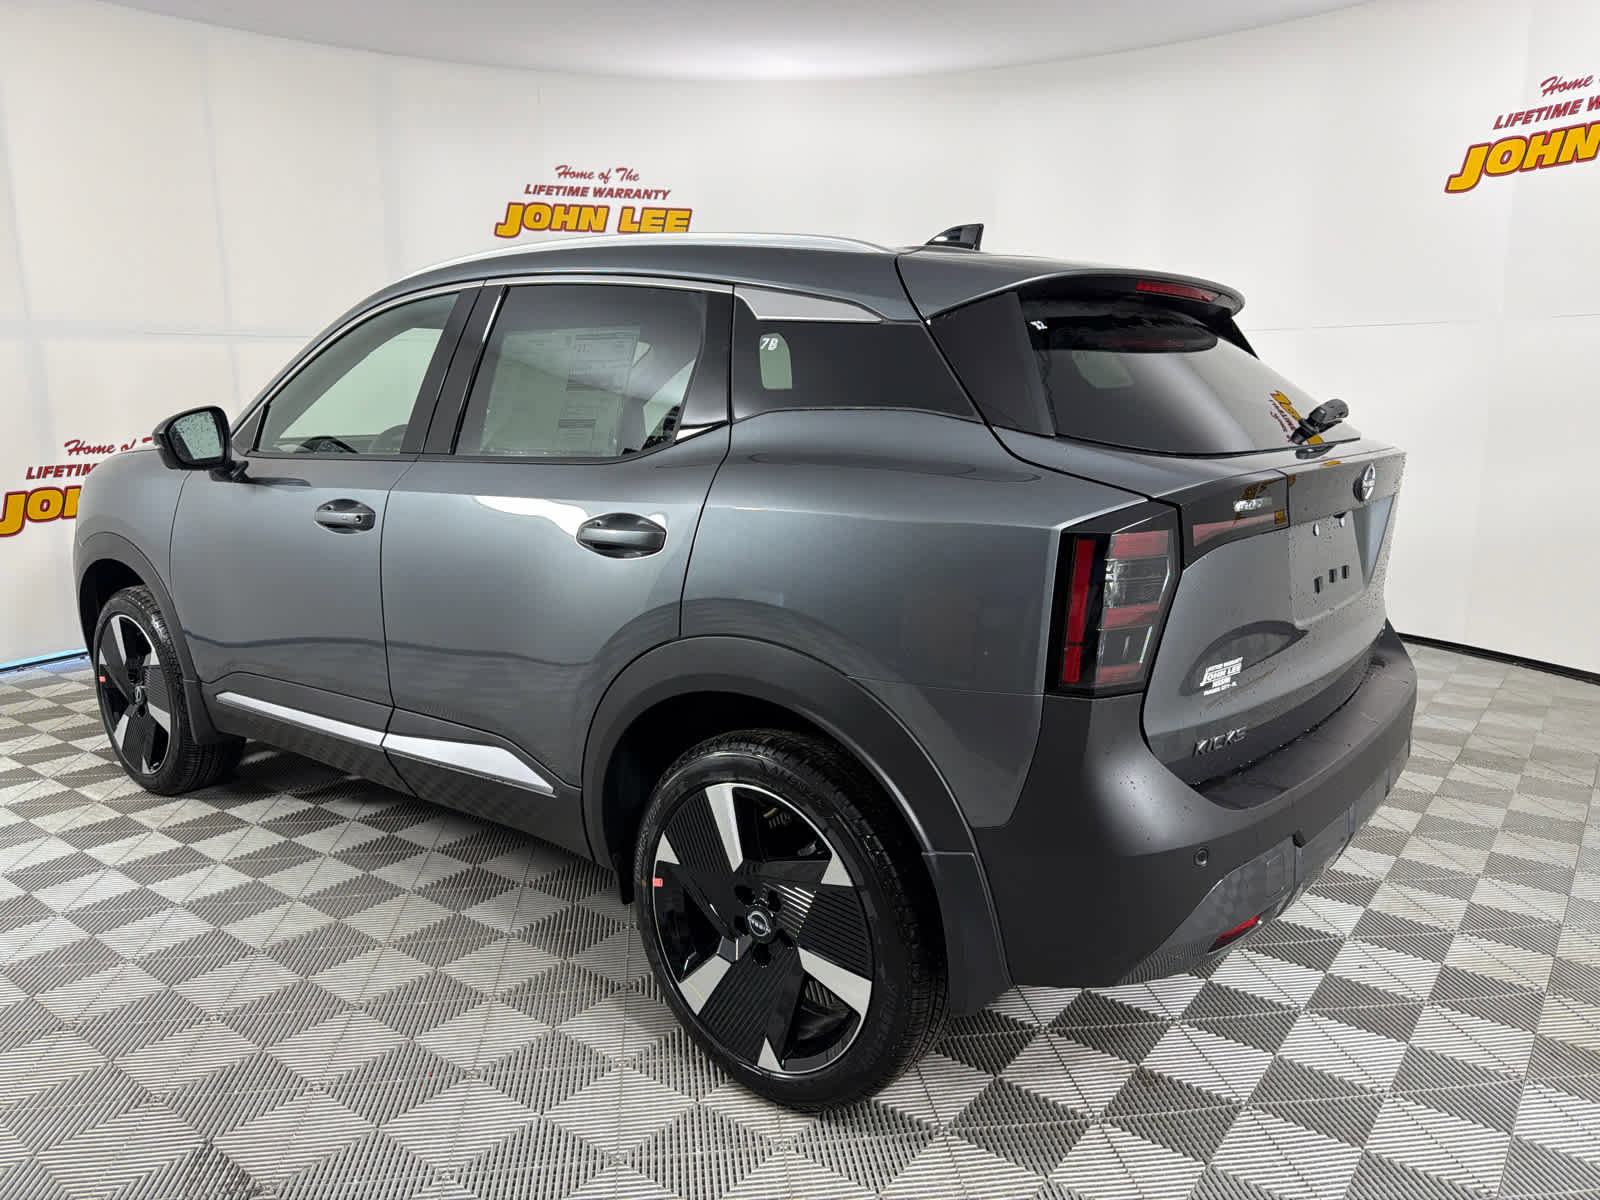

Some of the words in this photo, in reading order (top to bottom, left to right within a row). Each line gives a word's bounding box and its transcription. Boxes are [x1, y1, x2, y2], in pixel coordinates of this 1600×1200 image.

[1540, 75, 1593, 97] Home
[1493, 98, 1584, 130] LIFETIME
[1444, 120, 1600, 194] JOHN
[555, 164, 594, 181] Home
[598, 168, 612, 183] of
[615, 167, 640, 182] The
[524, 184, 590, 198] LIFETIME
[592, 186, 671, 200] WARRANTY
[494, 201, 610, 238] JOHN
[617, 206, 692, 233] LEE
[64, 439, 116, 456] Home
[26, 463, 101, 480] LIFETIM
